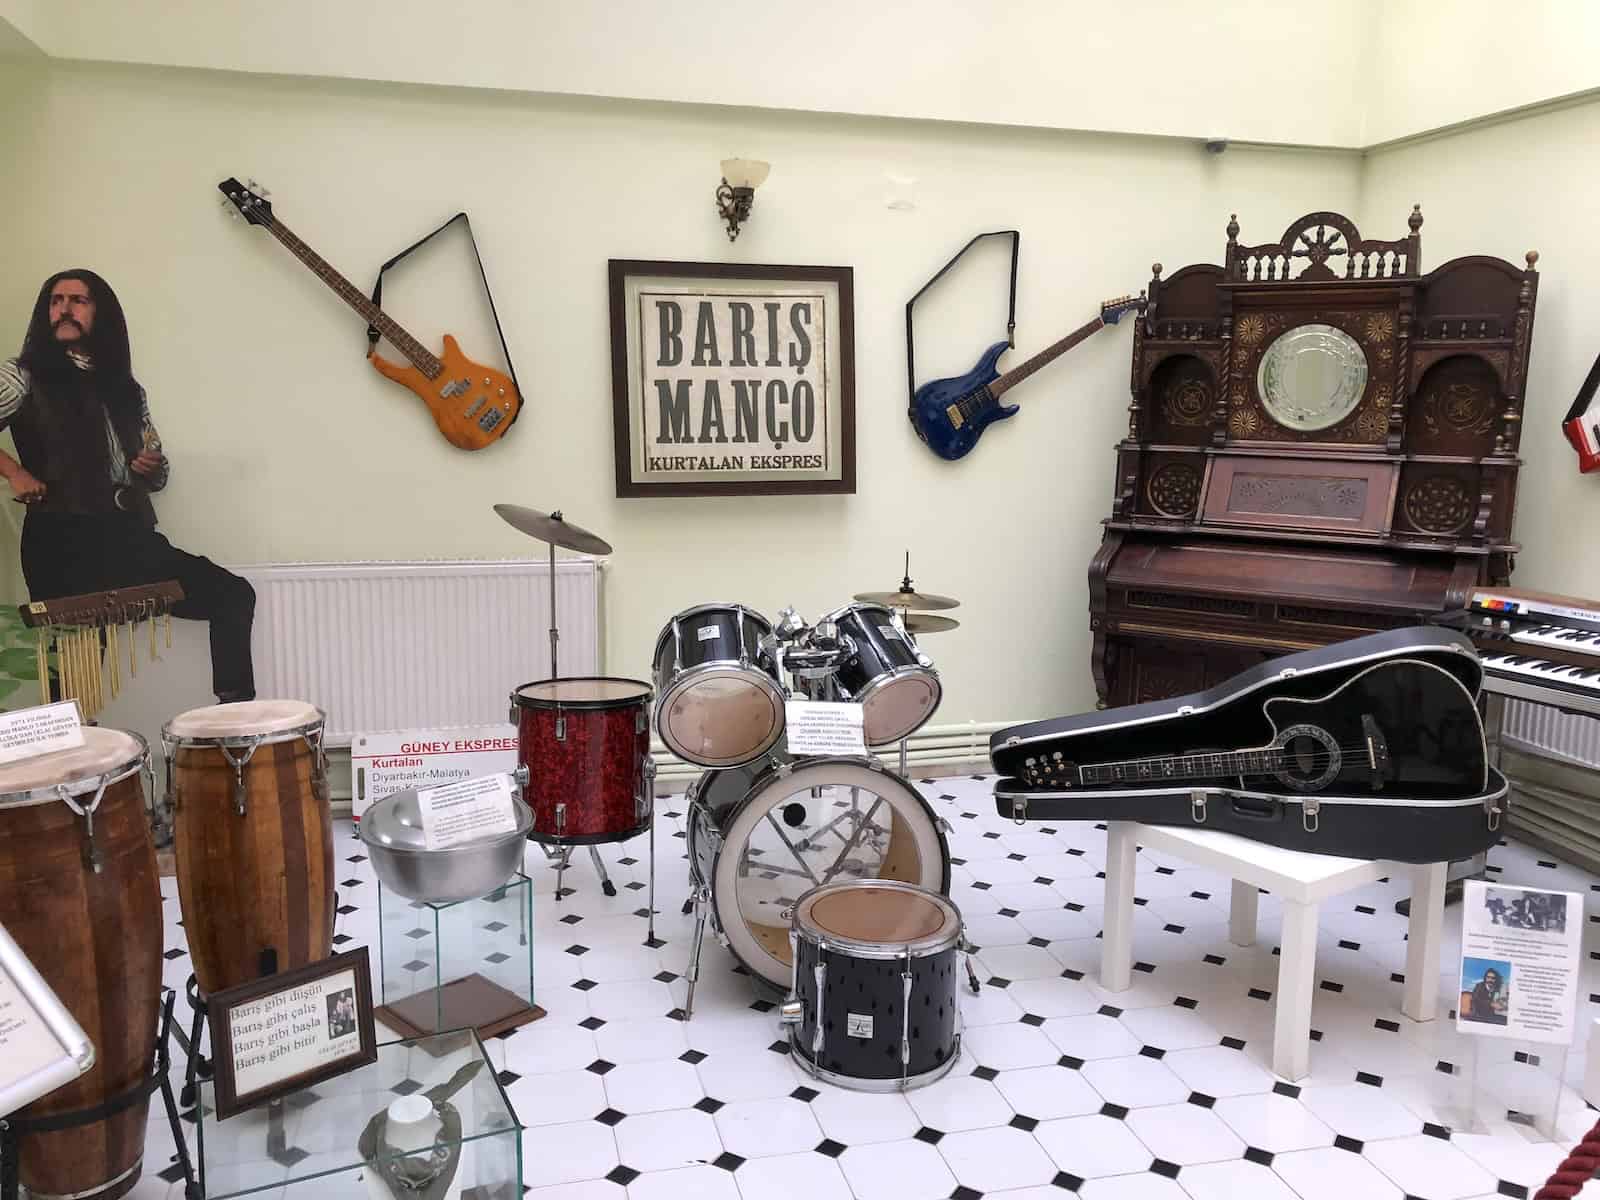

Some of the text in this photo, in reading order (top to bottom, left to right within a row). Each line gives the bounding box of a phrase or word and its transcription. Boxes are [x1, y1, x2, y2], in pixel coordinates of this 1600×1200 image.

[656, 301, 812, 375] BARIŞ
[654, 379, 815, 450] MANÇO
[650, 455, 823, 471] KURTALAN EKSPRES
[401, 741, 450, 753] GÜNEY
[372, 757, 423, 768] Kurtalan
[231, 983, 323, 1020] Barış gibi düşün
[232, 1022, 263, 1037] Barış
[266, 1011, 288, 1029] gibi
[234, 1016, 321, 1054] Barış gibi başla
[236, 1054, 265, 1071] Barış
[269, 1043, 291, 1061] gibi
